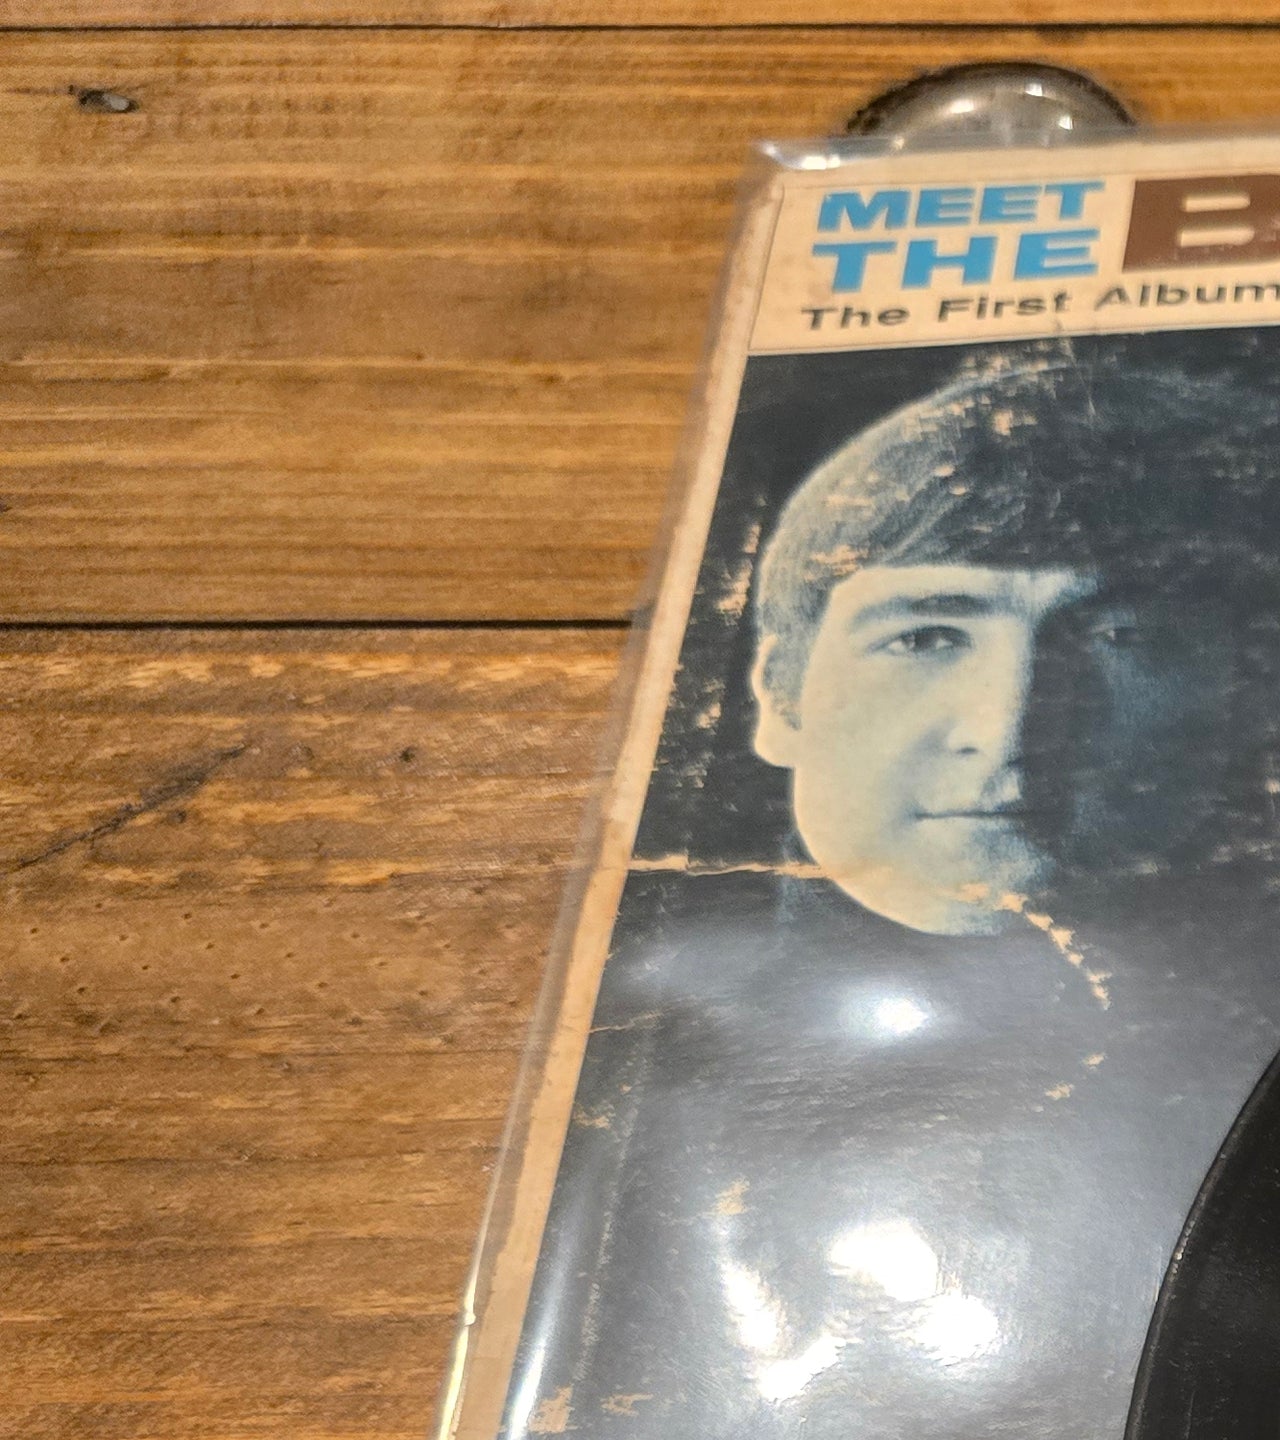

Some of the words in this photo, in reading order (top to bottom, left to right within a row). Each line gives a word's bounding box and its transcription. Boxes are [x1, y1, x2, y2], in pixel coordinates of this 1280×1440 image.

[817, 180, 1105, 233] MEET
[812, 229, 1101, 293] THE
[801, 306, 910, 332] The
[936, 290, 1071, 322] First
